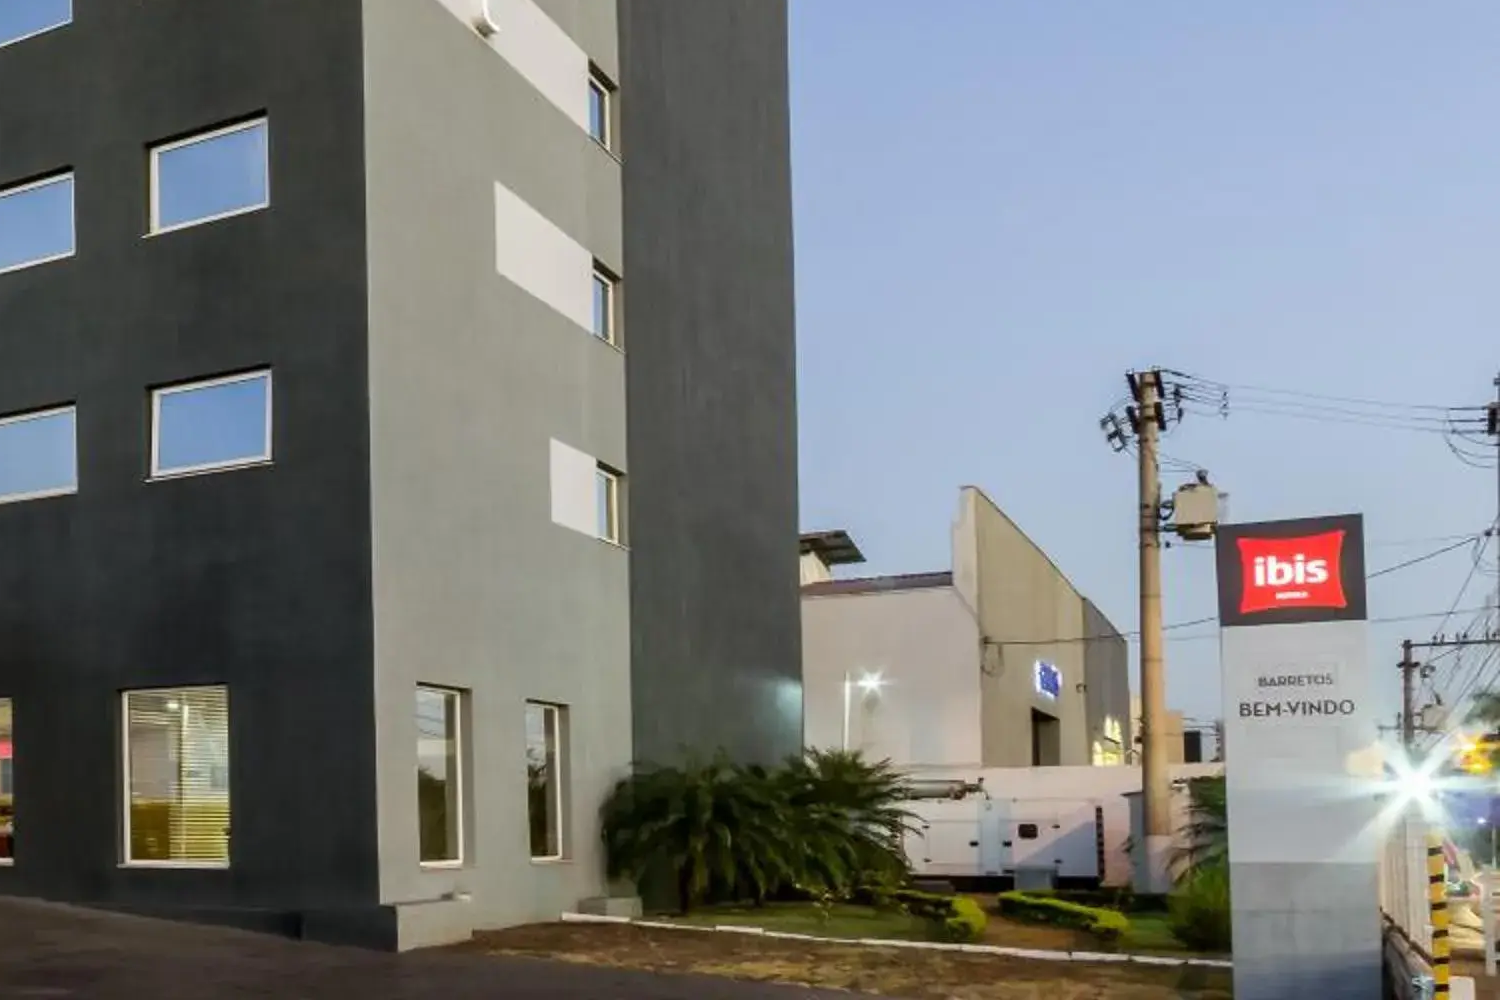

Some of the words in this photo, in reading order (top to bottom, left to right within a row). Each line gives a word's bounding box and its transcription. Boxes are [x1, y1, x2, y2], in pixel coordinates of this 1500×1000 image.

[1254, 553, 1329, 587] ibis
[1257, 673, 1333, 687] BARRETOS
[1239, 699, 1355, 717] BEM-VINDO
